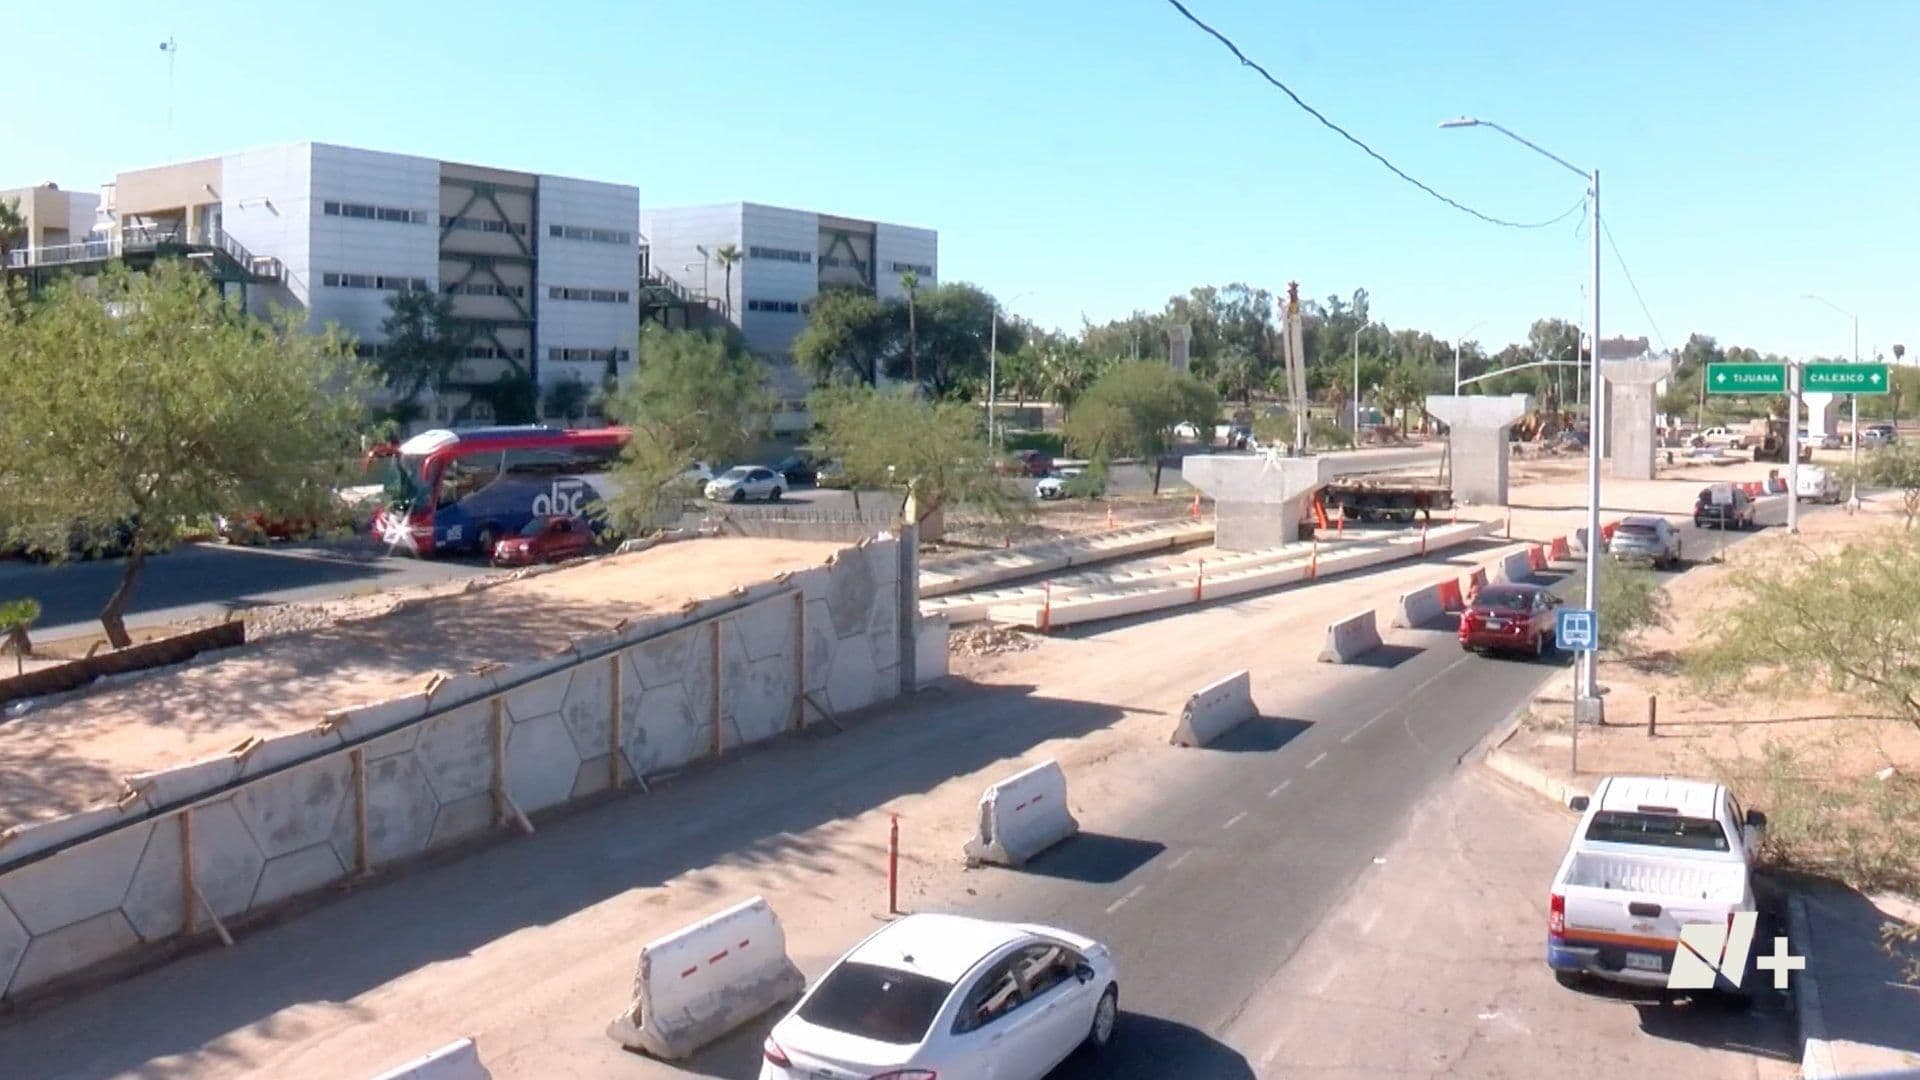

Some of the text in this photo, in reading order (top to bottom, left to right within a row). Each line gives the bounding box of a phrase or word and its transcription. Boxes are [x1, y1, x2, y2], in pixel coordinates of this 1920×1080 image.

[1733, 373, 1778, 383] TIJUANA
[1810, 373, 1864, 383] CALEXICO
[532, 481, 583, 519] abc
